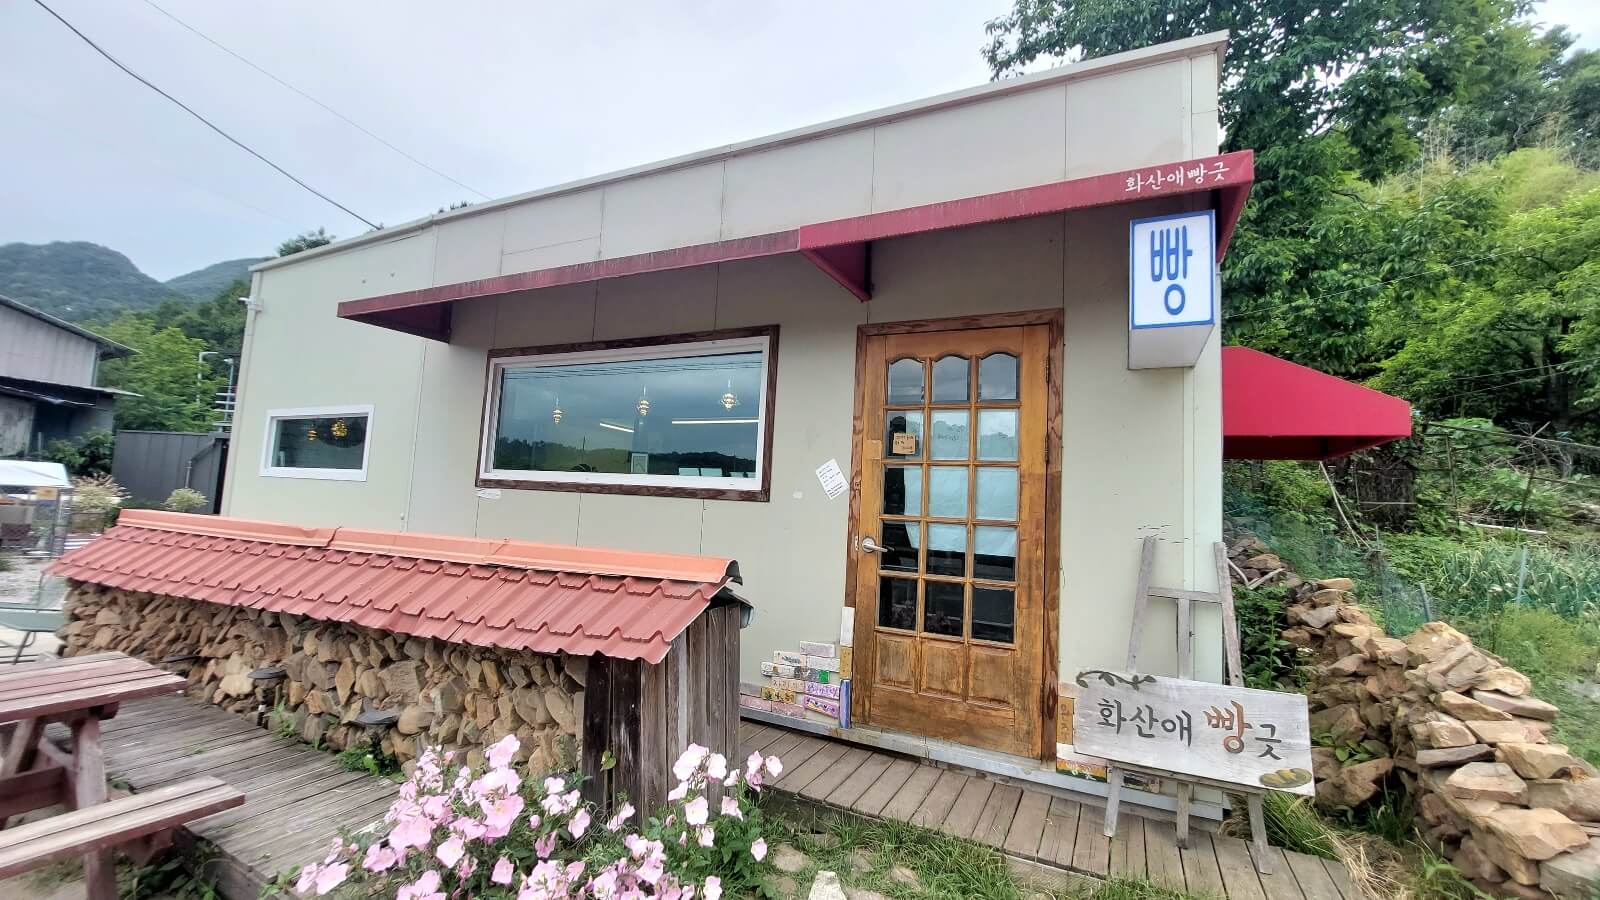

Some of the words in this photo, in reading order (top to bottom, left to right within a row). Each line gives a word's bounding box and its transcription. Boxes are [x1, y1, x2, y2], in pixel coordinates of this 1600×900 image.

[1125, 161, 1230, 192] 화산애빵긋
[1150, 224, 1193, 316] 빵
[1096, 697, 1193, 748] 화산애
[1202, 700, 1282, 761] 빵긋
